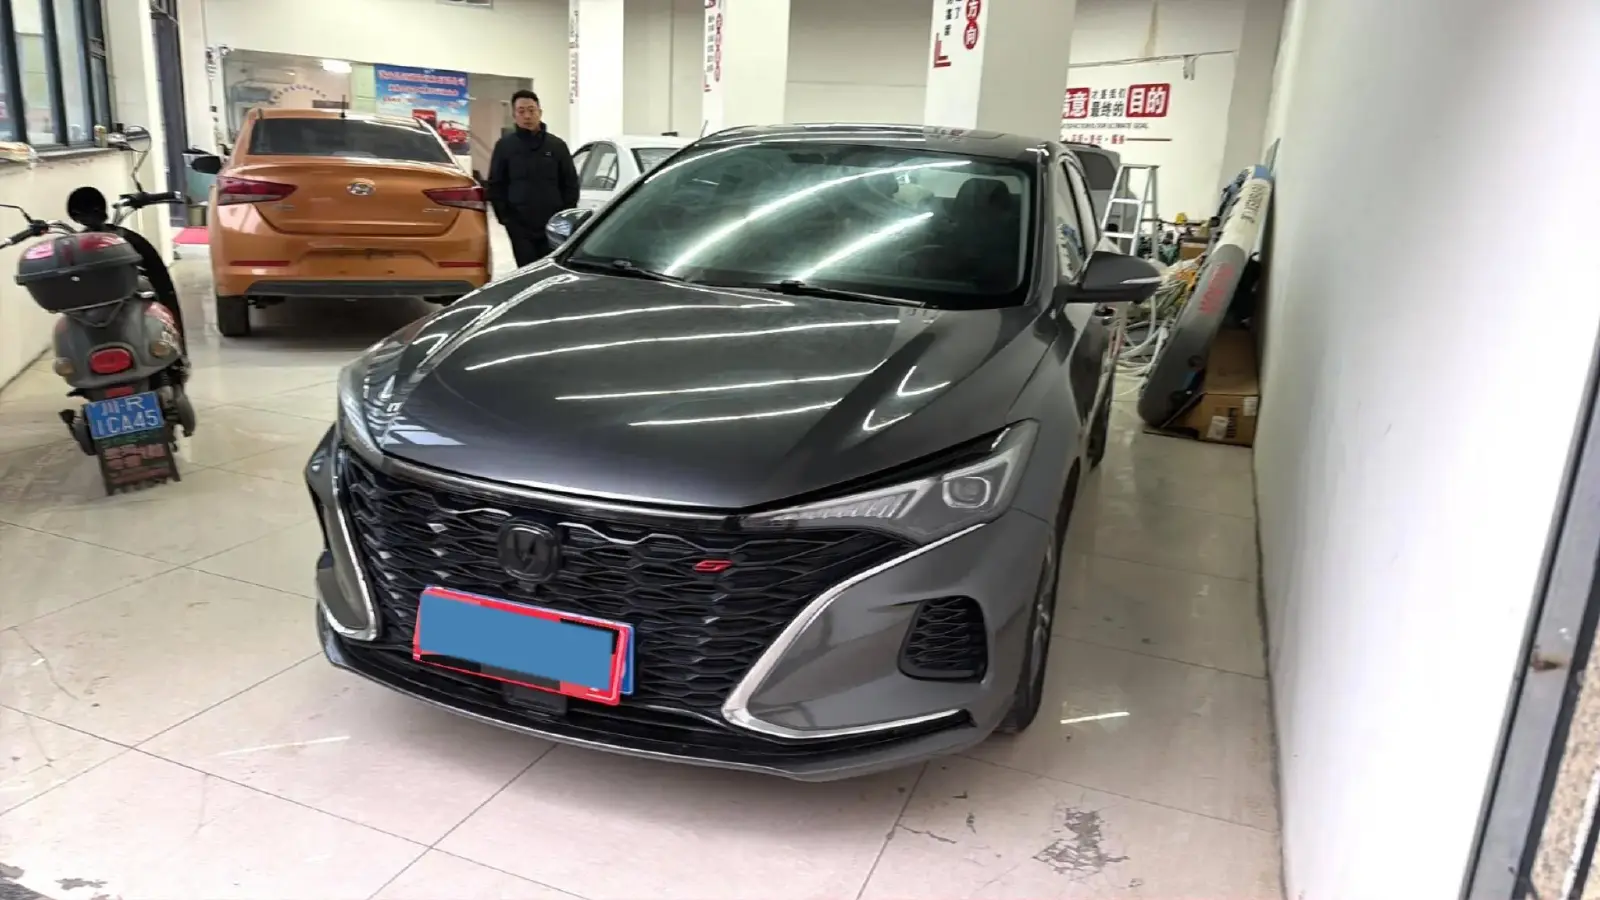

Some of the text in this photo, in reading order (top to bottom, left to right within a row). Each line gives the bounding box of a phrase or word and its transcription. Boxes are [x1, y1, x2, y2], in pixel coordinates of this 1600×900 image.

[1063, 90, 1088, 117] 意
[1091, 101, 1124, 117] 最终的
[1128, 86, 1168, 114] 目的
